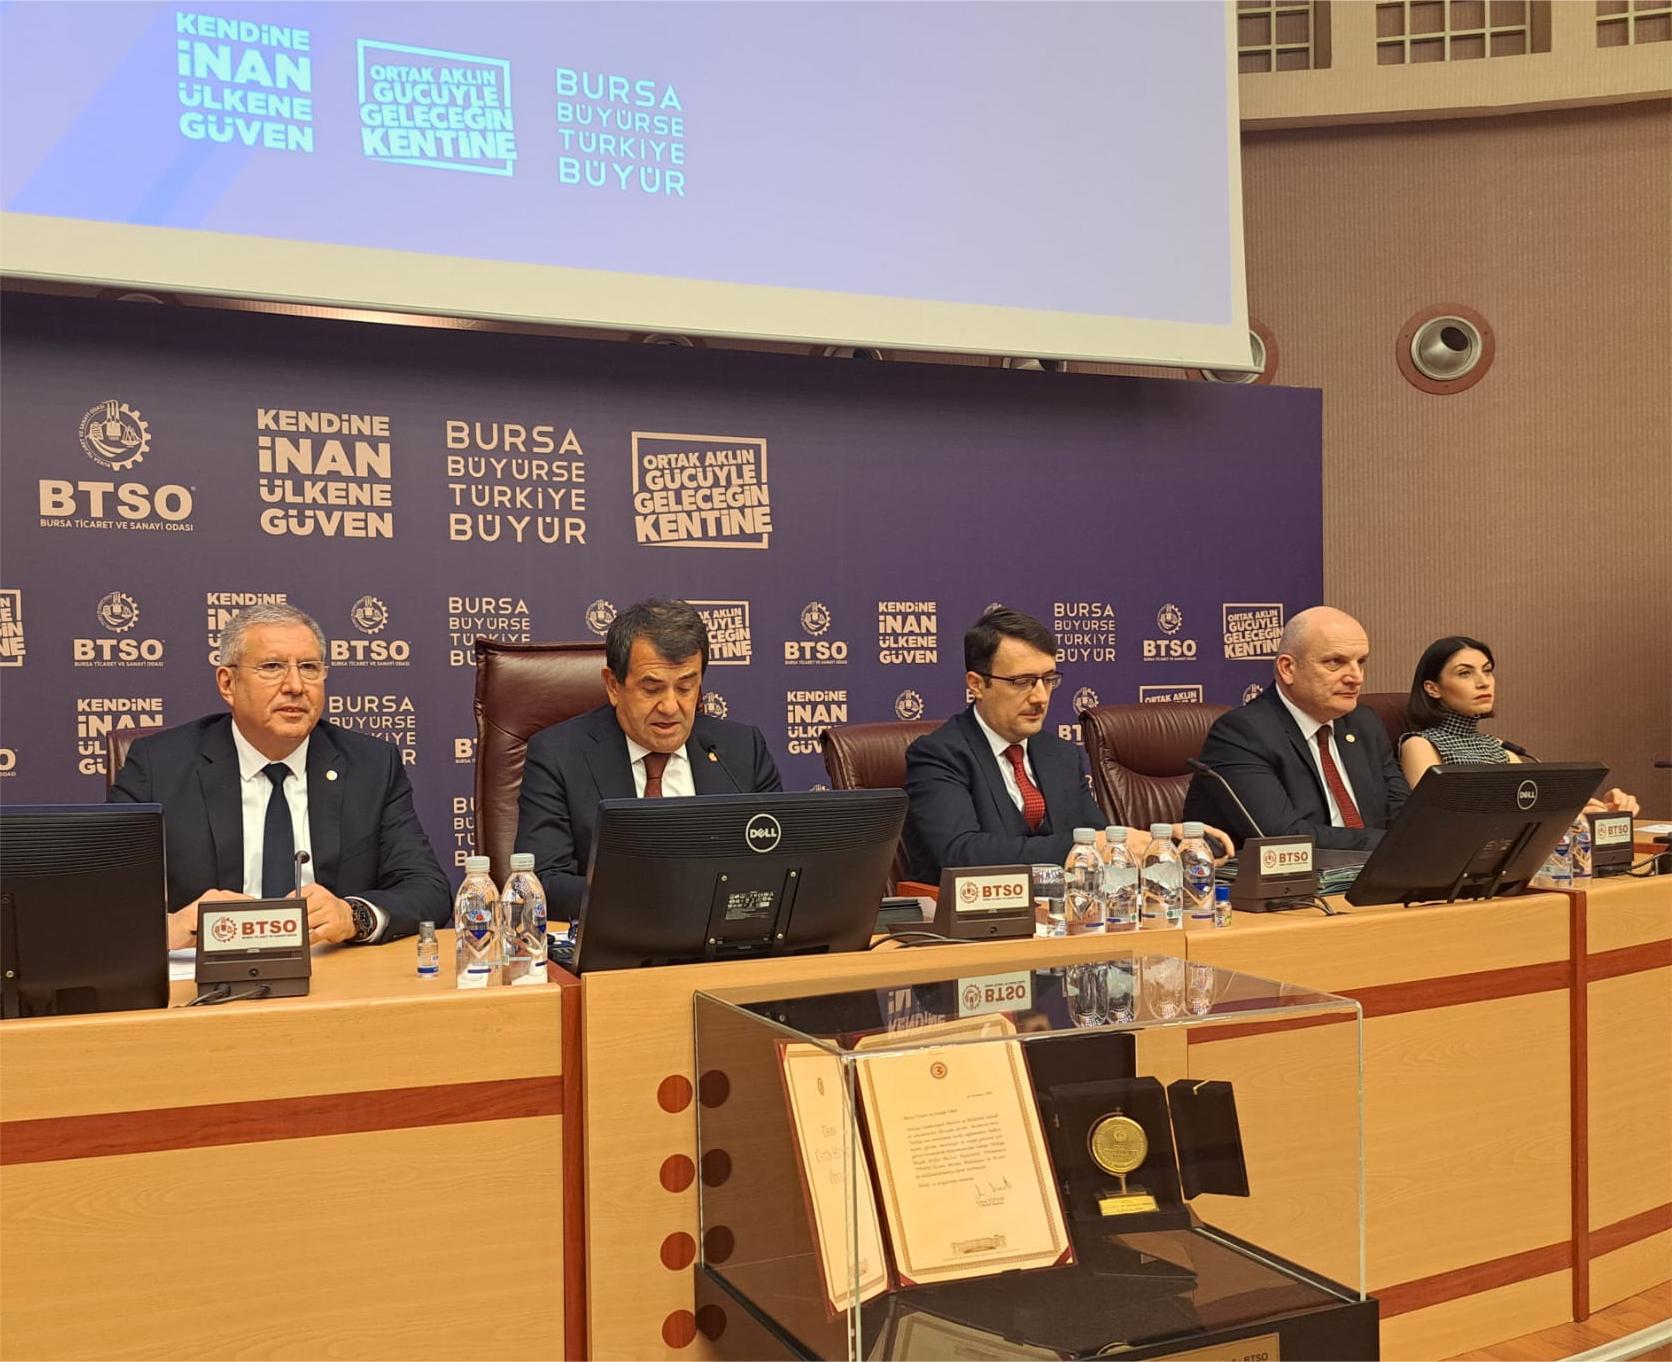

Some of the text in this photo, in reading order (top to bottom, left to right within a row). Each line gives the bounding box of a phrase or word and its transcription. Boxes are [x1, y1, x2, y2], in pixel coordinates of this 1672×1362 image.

[176, 12, 310, 51] KENDİNE
[177, 40, 311, 92] İNAN
[370, 65, 496, 85] ORTAK AKLIN
[556, 68, 682, 111] BURSA
[178, 82, 312, 121] ÜLKENE
[557, 101, 683, 137] BÜYÜRSE
[179, 112, 313, 152] GÜVEN
[559, 156, 685, 196] BÜYÜR
[257, 408, 390, 437] KENDİNE
[446, 420, 584, 455] BURSA
[258, 436, 392, 479] İNAN
[643, 449, 754, 470] ORTAK AKLIN
[447, 455, 585, 483] BÜYÜRSE
[39, 479, 193, 521] BTSO
[259, 479, 393, 507] ÜLKENE
[448, 483, 585, 511] TÜRKİYE
[40, 519, 193, 531] BURSA TİCARET VE SANAYİ ODASI
[260, 508, 393, 539] GÜVEN
[449, 513, 586, 544] BÜYÜR
[635, 506, 773, 543] KENTİNE
[207, 593, 287, 605] KENDİNE
[448, 597, 529, 614] BURSA
[878, 601, 936, 613] KENDİNE
[1054, 603, 1114, 617] BURSA
[449, 617, 531, 630] BÜYÜRSE
[879, 615, 937, 634] İNAN
[74, 639, 163, 661] BTSO
[331, 640, 410, 661] BTSO
[785, 641, 847, 660] BTSO
[879, 636, 937, 648] ÜLKENE
[1143, 639, 1197, 657] BTSO
[879, 650, 937, 664] GÜVEN
[1055, 648, 1116, 662] BÜYÜR
[77, 698, 163, 712] KENDİNE
[329, 695, 415, 713] BURSA
[787, 690, 848, 702] KENDİNE
[787, 704, 848, 723] İNAN
[1058, 724, 1082, 741] BT
[1520, 791, 1536, 799] DELL
[749, 828, 778, 838] DELL
[1608, 824, 1629, 835] BTSO
[1278, 851, 1309, 864] BTSO
[983, 883, 1023, 898] BTSO
[242, 919, 297, 936] BTSO
